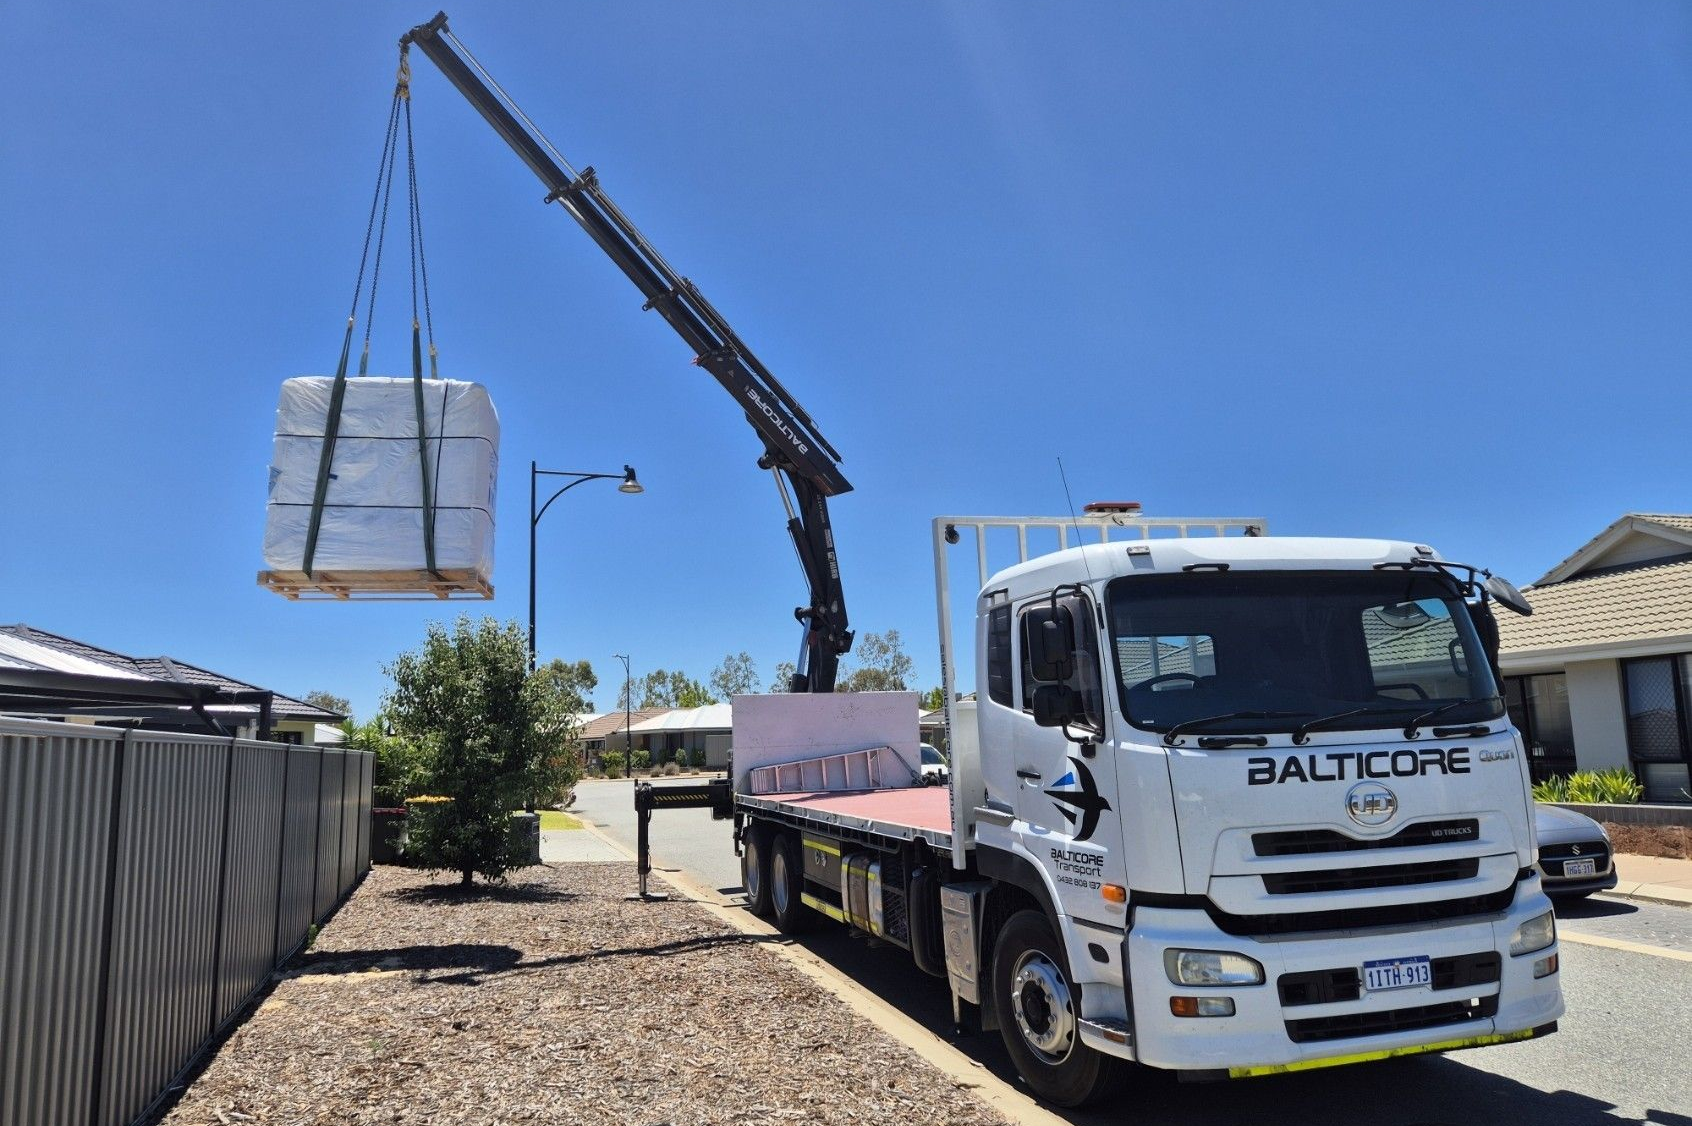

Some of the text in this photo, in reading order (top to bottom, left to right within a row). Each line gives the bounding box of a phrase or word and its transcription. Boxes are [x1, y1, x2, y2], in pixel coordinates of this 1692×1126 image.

[747, 388, 809, 455] BALTICORE
[1248, 747, 1471, 786] BALTICORE
[1431, 827, 1472, 837] UD TRUCKS
[1051, 848, 1104, 867] BALTICORE
[1054, 860, 1102, 877] Transport
[1057, 875, 1073, 884] 0432
[1074, 878, 1088, 888] 808
